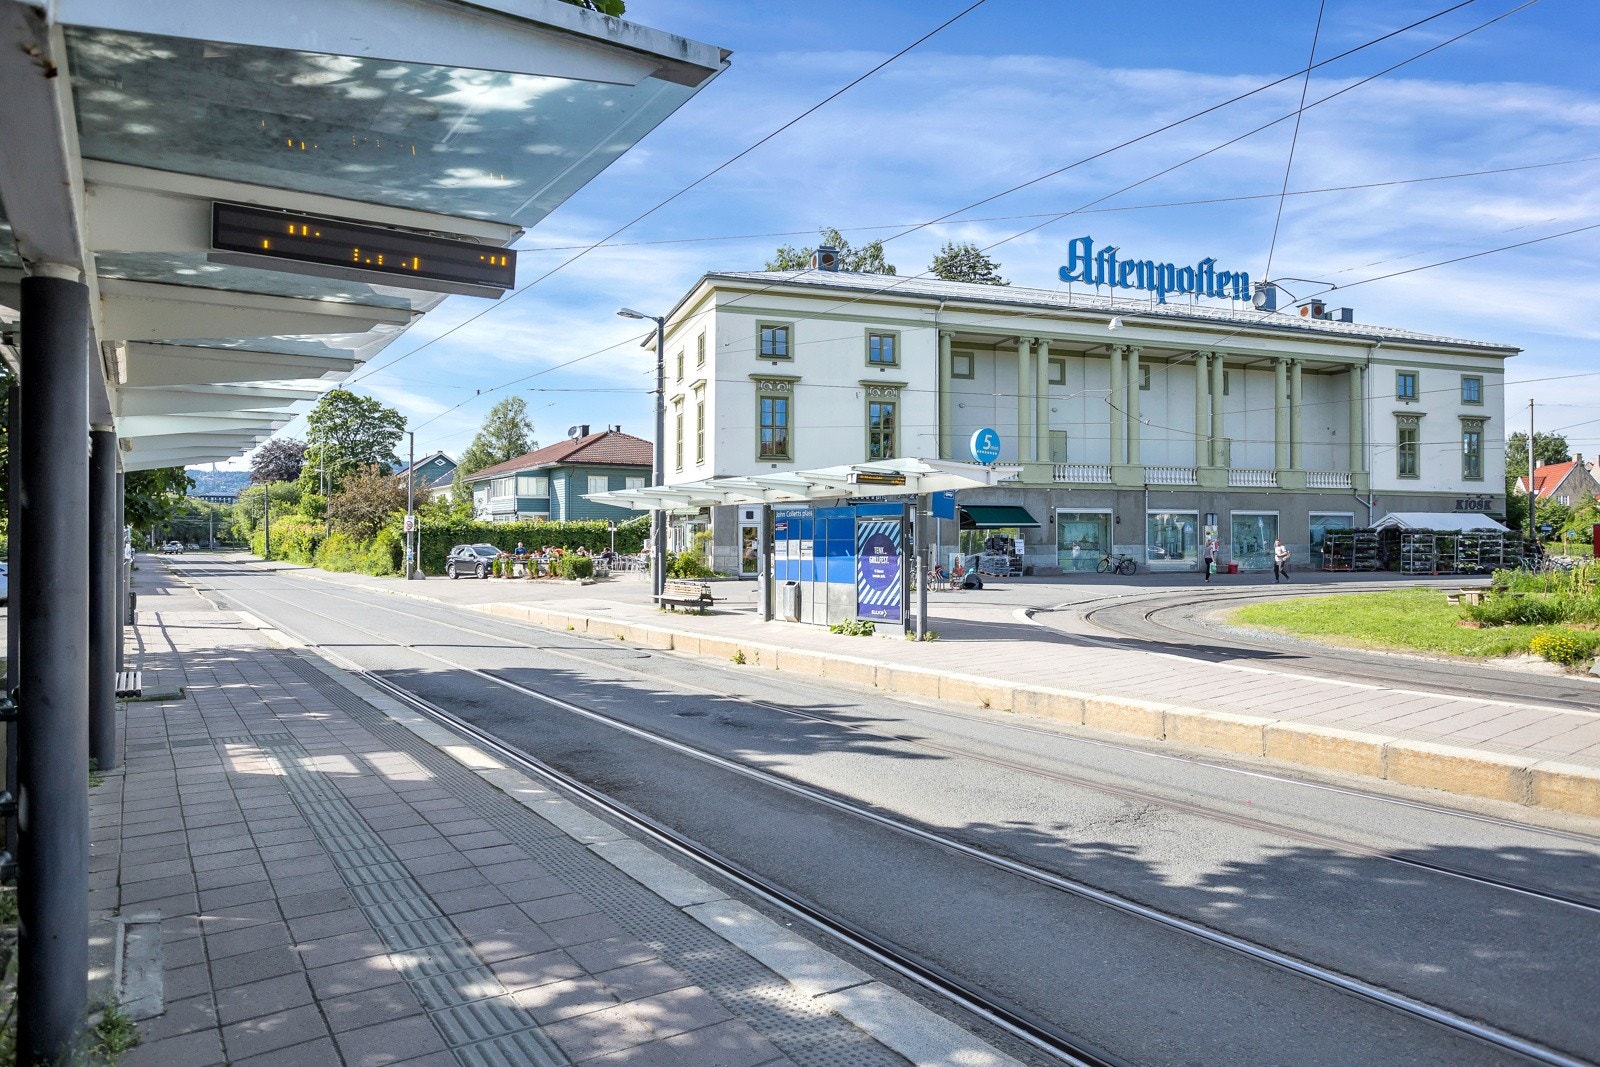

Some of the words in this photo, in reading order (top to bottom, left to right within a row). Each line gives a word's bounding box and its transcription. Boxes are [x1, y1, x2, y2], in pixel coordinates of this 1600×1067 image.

[1058, 235, 1251, 304] Aftenposten
[983, 434, 992, 450] 5
[1455, 500, 1492, 510] KIOSK
